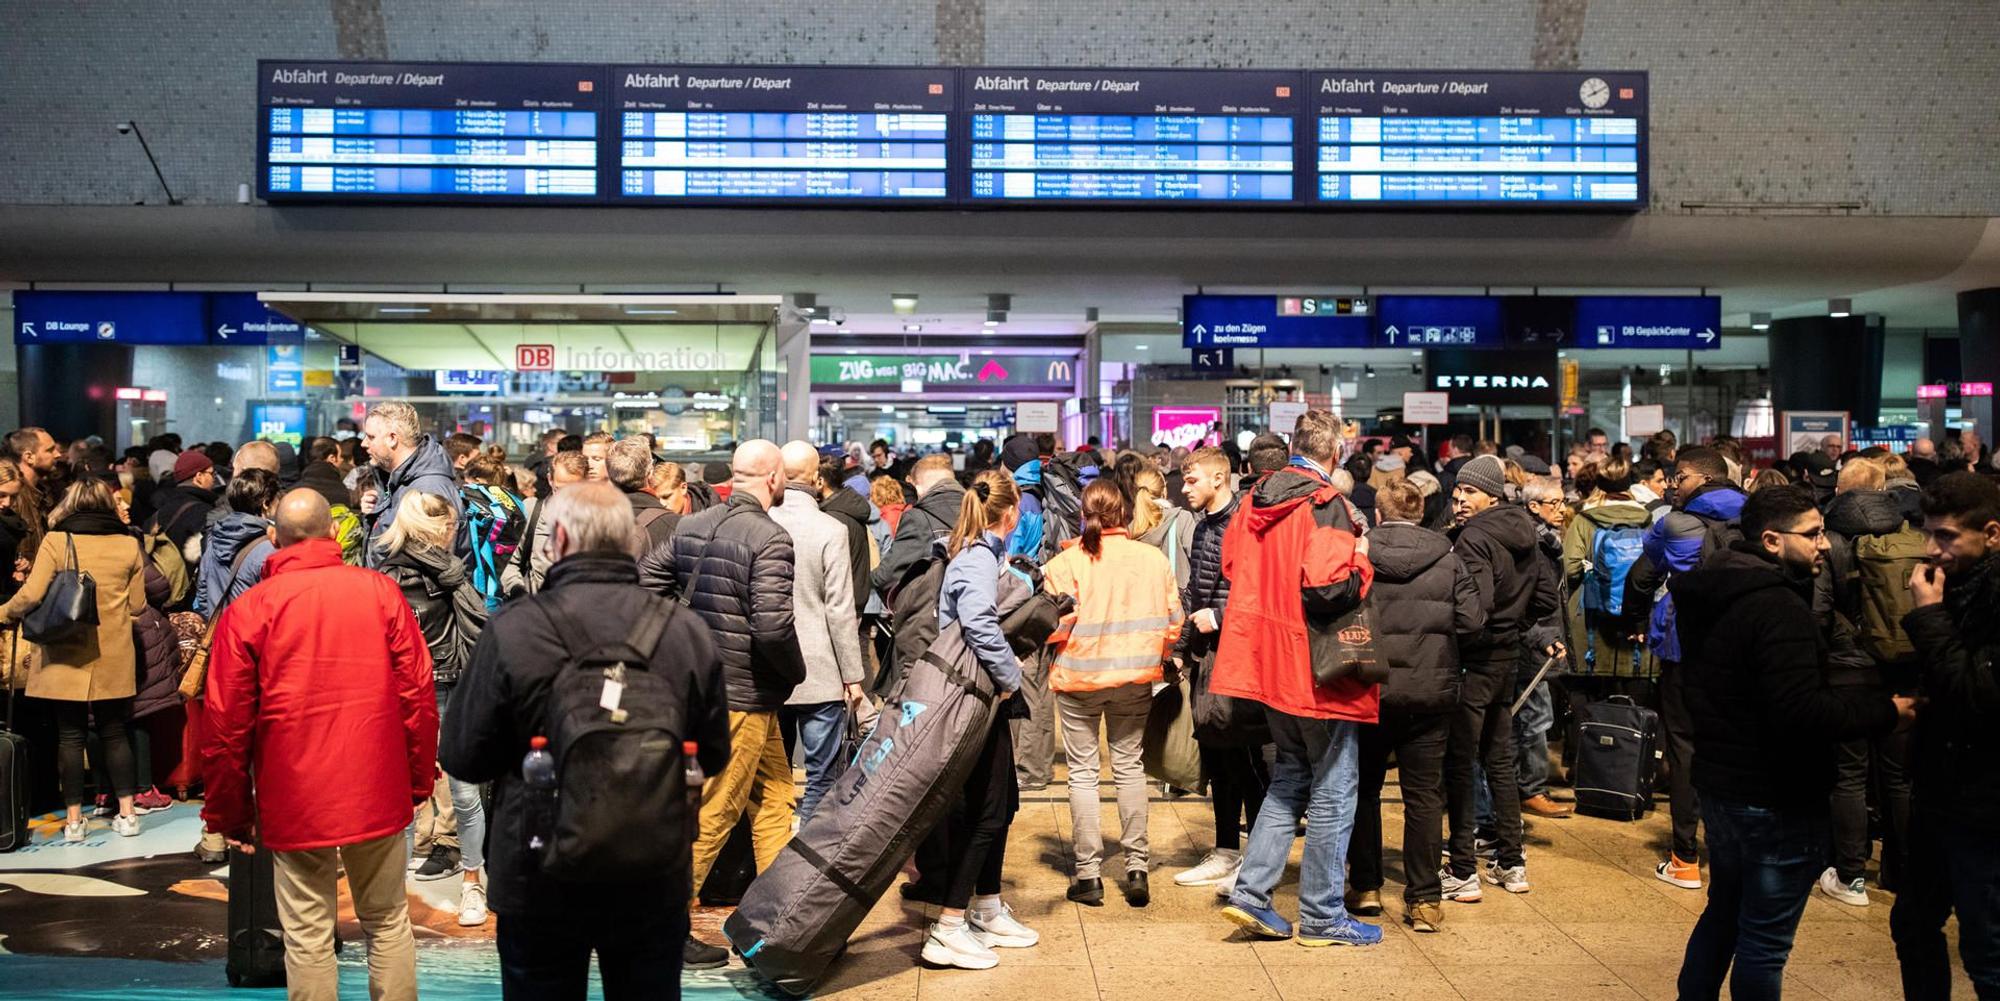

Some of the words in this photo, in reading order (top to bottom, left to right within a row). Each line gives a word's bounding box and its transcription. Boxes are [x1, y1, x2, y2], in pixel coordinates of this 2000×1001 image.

[272, 68, 328, 84] Abfahrt
[335, 73, 394, 87] Departure
[403, 73, 444, 87] Départ
[624, 73, 680, 88] Abfahrt
[687, 77, 743, 90] Departure
[753, 77, 792, 90] Départ
[974, 76, 1029, 91] Abfahrt
[1036, 79, 1092, 92] Departure
[1102, 79, 1140, 92] Départ
[1320, 78, 1375, 93] Abfahrt
[1382, 81, 1439, 95] Departure
[1450, 81, 1489, 95] Départ
[1303, 298, 1316, 314] S
[60, 321, 90, 332] Lounge
[1214, 325, 1224, 333] zu
[1225, 323, 1240, 333] den
[1241, 323, 1267, 335] Zügen
[1622, 326, 1635, 336] DB
[520, 348, 550, 367] DB
[566, 346, 726, 369] Information
[1215, 349, 1223, 365] 1
[838, 360, 873, 380] ZUG
[902, 362, 927, 377] BIG
[928, 360, 974, 382] MAC.
[1437, 376, 1549, 388] ETERNA
